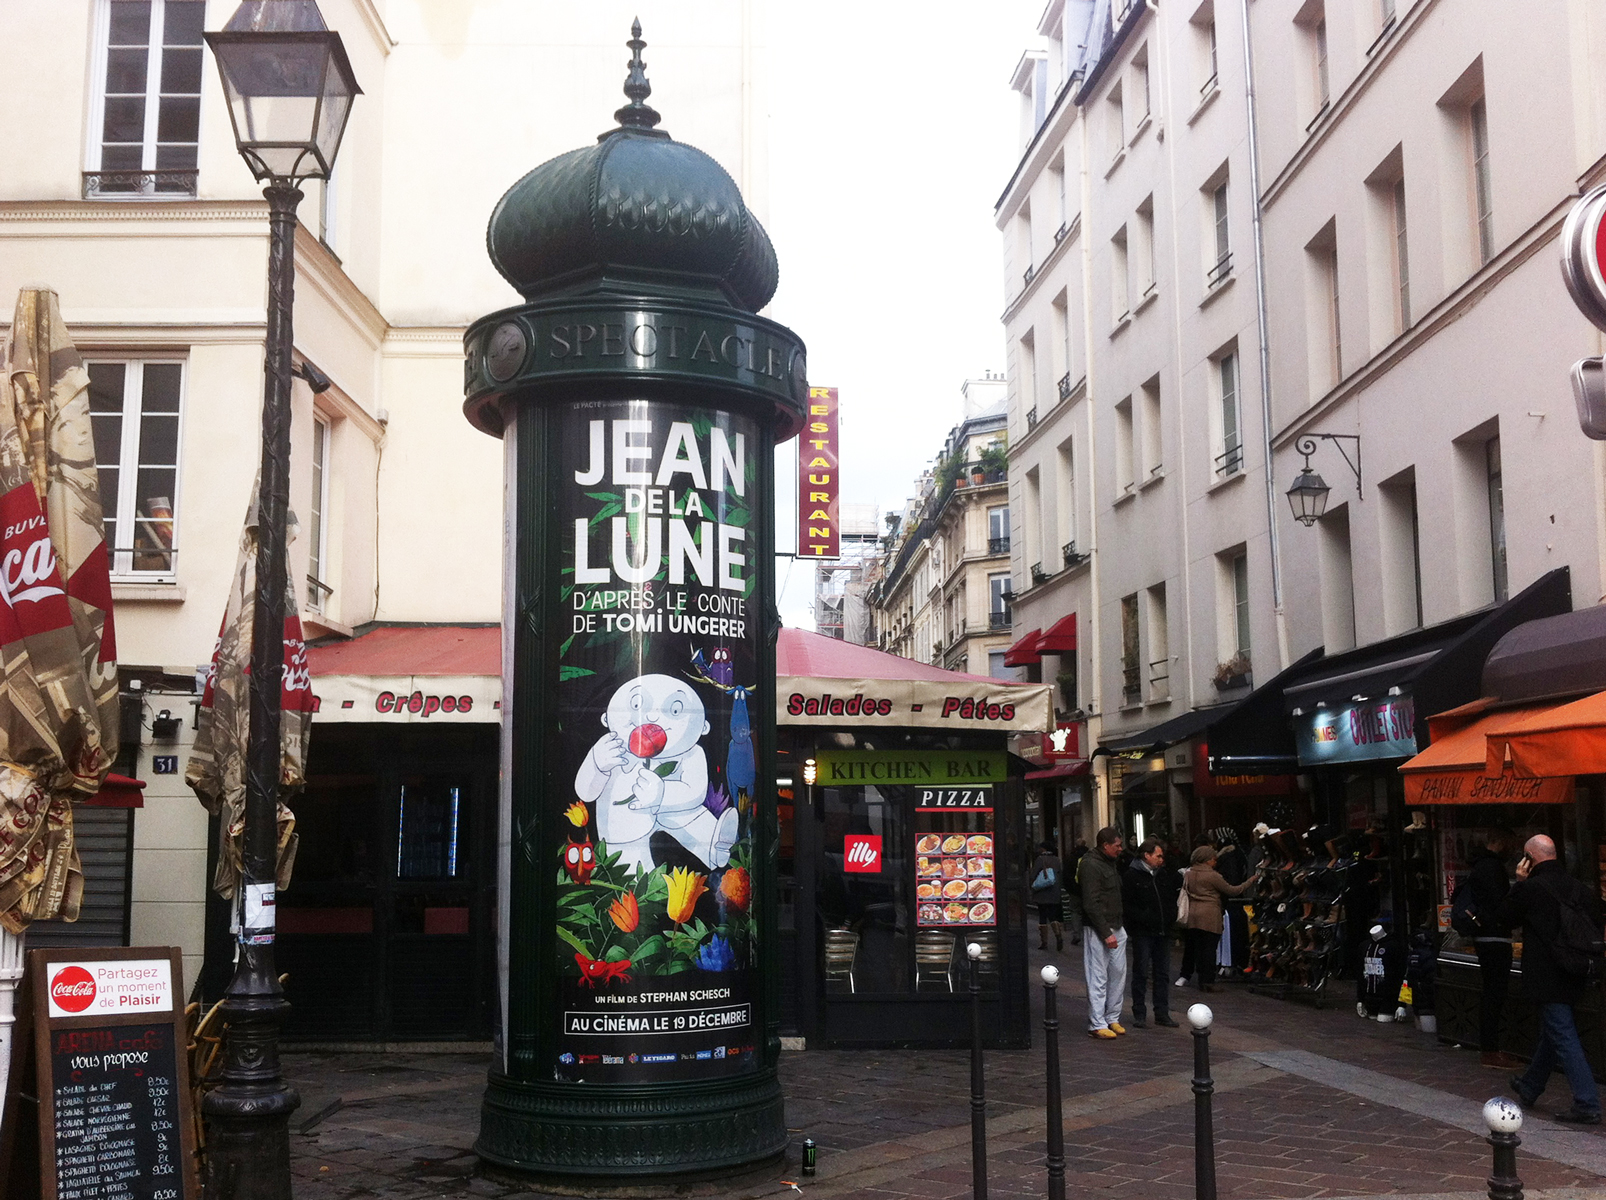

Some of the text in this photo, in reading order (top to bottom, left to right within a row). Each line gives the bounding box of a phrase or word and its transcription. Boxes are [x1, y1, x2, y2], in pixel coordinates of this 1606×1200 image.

[550, 323, 784, 381] SPECTACLE
[574, 419, 745, 497] JEAN
[808, 387, 830, 555] RESTAURANT
[625, 488, 704, 517] DE LA
[574, 516, 745, 592] LUNE
[573, 586, 745, 617] D'APRÈS LE CONTE
[573, 614, 596, 633] DE
[668, 615, 745, 639] UNGERER
[375, 690, 473, 718] Crêpes
[787, 693, 1016, 721] Salades Pâtes
[1350, 704, 1389, 745] OUTLET
[157, 758, 173, 772] 31
[831, 760, 992, 780] KITCHEN BAR
[921, 790, 986, 806] PIZZA
[1418, 777, 1464, 802] PANINI
[848, 841, 878, 867] illy
[97, 968, 158, 980] Partagez
[53, 980, 95, 997] Coca-Cola
[99, 981, 167, 993] un moment
[595, 995, 606, 1003] UN
[627, 995, 638, 1003] DE
[640, 993, 688, 1003] STEPHAN
[689, 988, 731, 1001] SCHESCH
[99, 994, 161, 1007] de Plaisir
[571, 1018, 590, 1031] AU
[653, 1017, 669, 1030] LE
[673, 1016, 685, 1029] 19
[689, 1009, 747, 1028] DÉCEMBRE
[70, 1051, 149, 1072] vous propose
